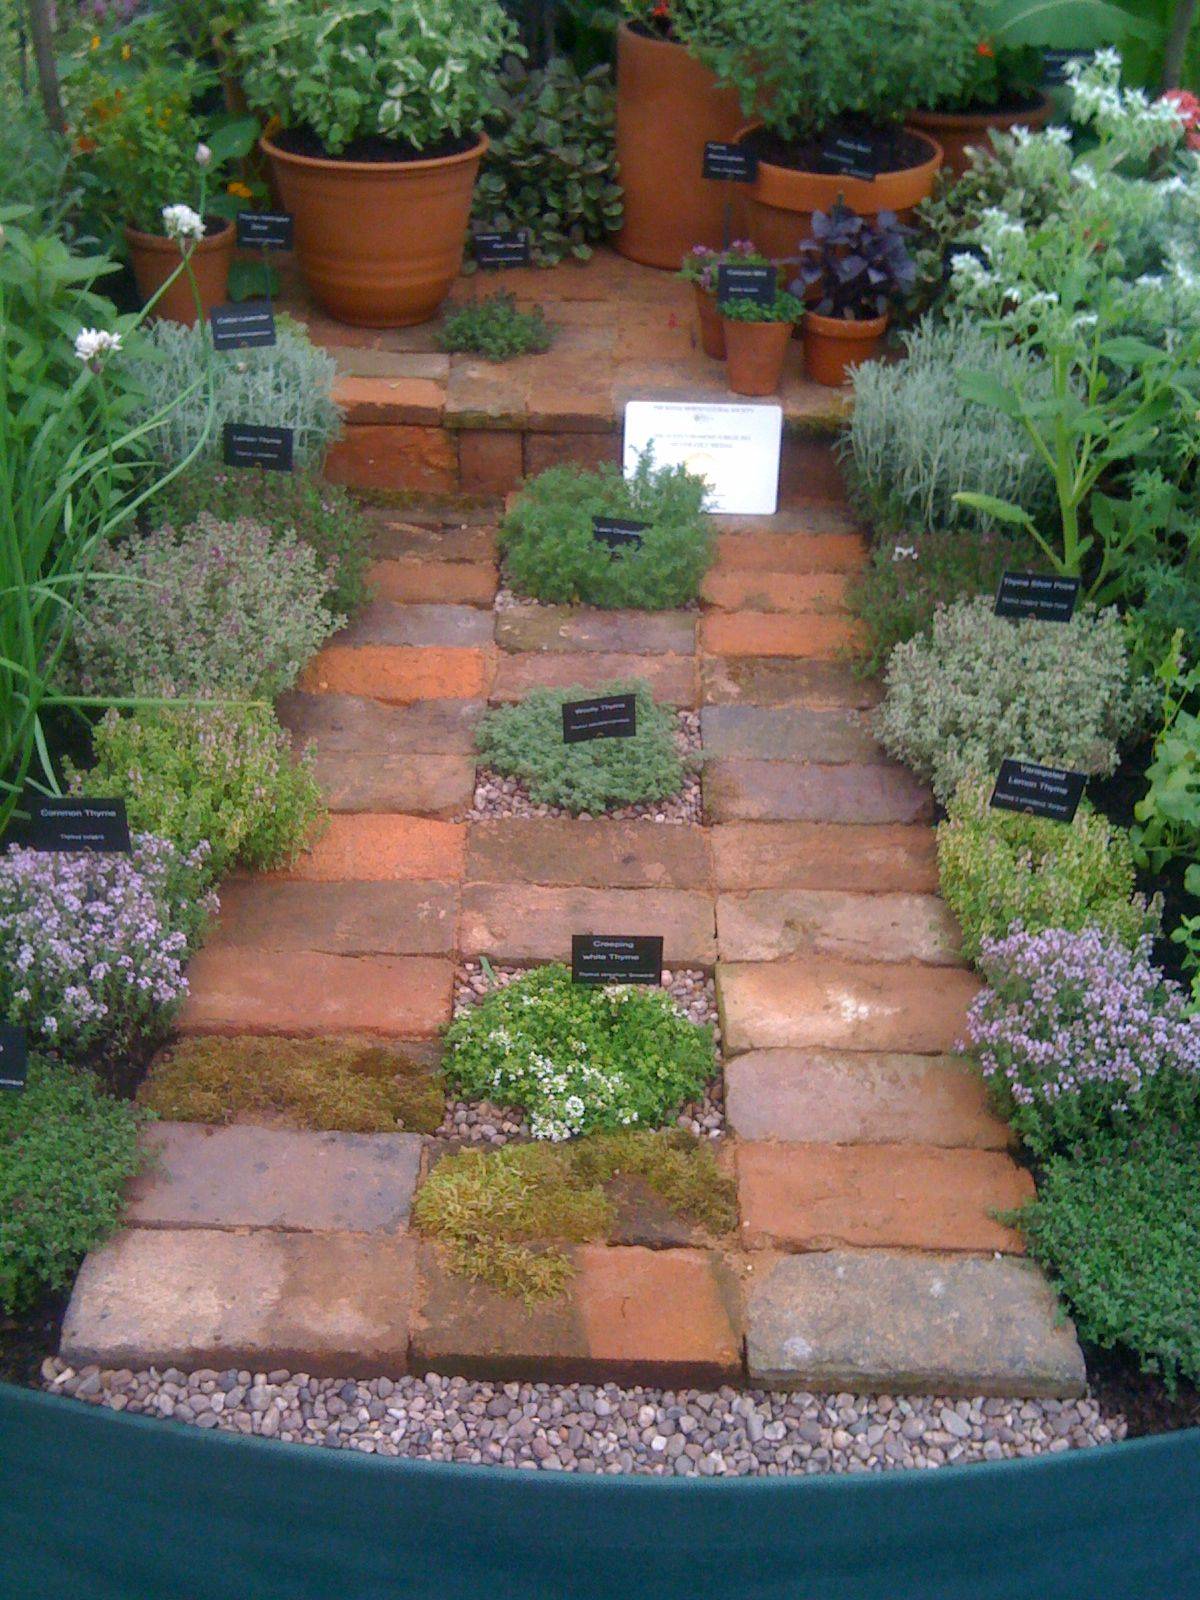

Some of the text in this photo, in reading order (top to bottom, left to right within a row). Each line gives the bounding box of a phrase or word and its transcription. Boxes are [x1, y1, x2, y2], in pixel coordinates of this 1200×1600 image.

[600, 703, 625, 711] Thyme
[1008, 775, 1069, 795] Lemon Thyme
[40, 808, 117, 818] Common Thyme
[593, 940, 635, 949] Creeping
[583, 953, 640, 962] white Thyme
